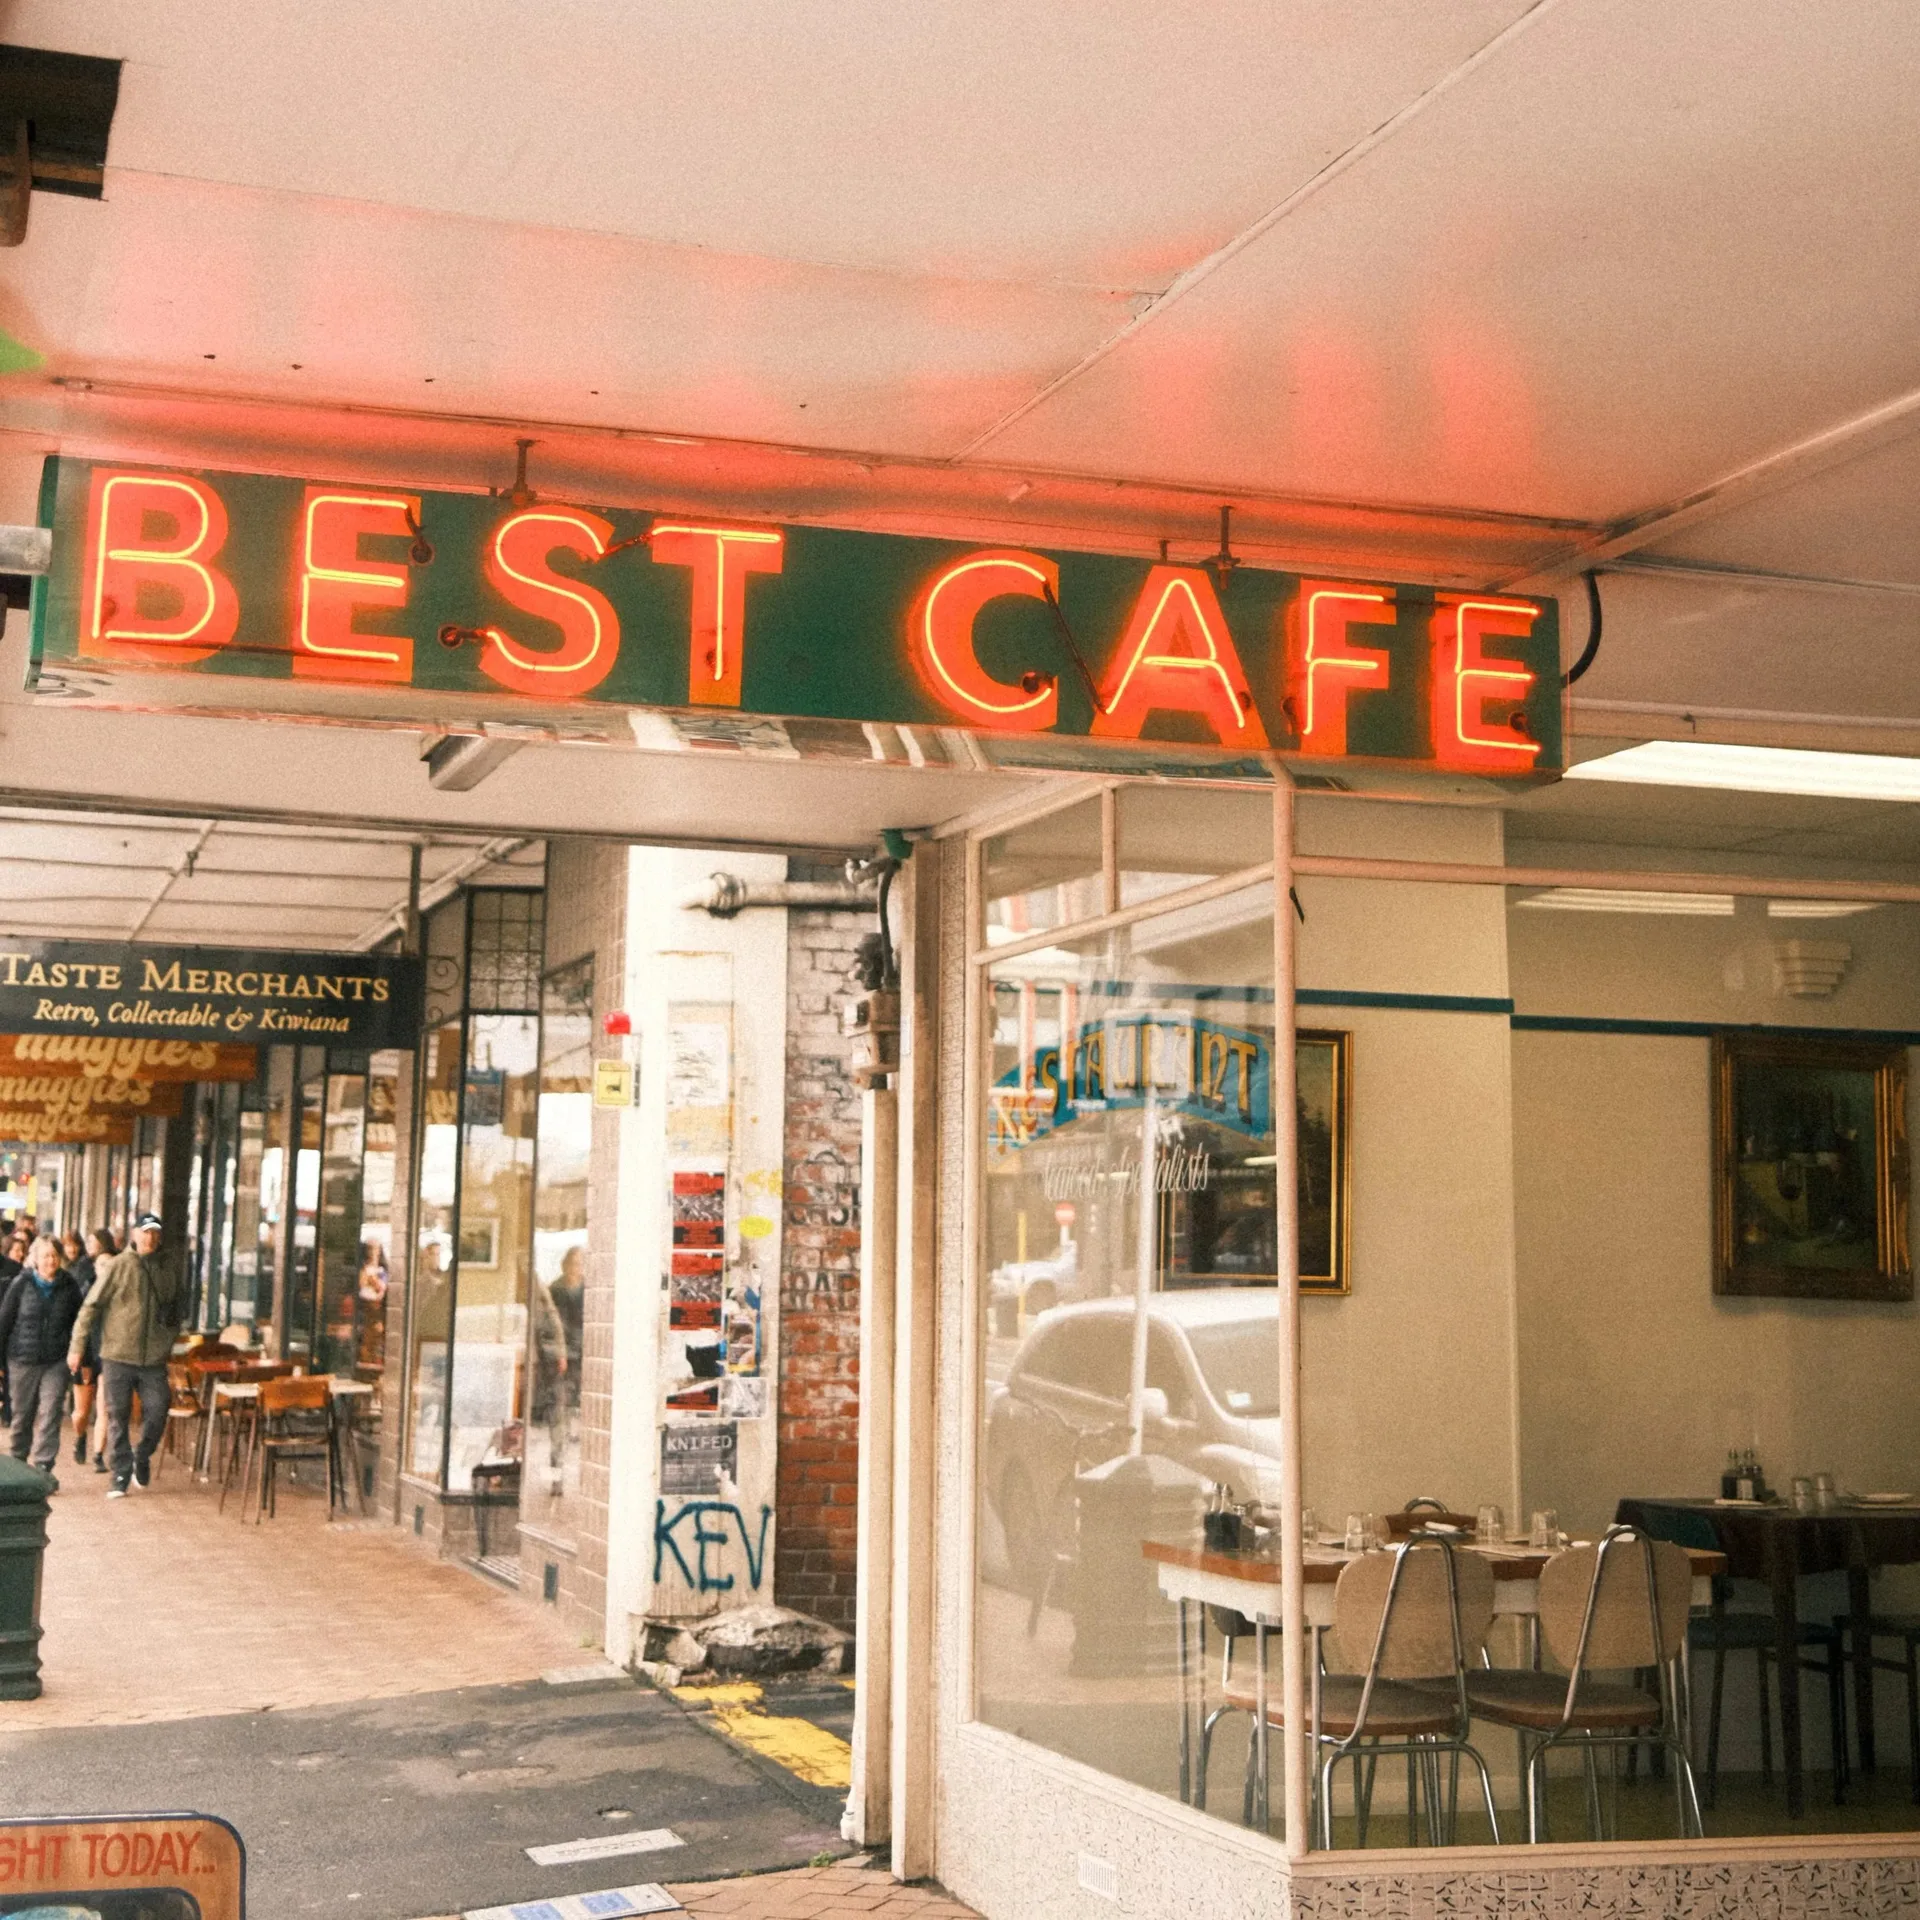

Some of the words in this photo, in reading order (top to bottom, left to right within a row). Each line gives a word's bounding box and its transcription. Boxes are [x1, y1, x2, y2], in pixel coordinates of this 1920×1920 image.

[77, 466, 784, 707] BEST
[906, 550, 1541, 773] CAFE
[33, 999, 99, 1028] Retro,
[107, 1000, 220, 1028] Collectable
[225, 1006, 253, 1032] &
[258, 1008, 350, 1033] Kiwiana
[666, 1434, 733, 1452] KNIFED
[653, 1498, 772, 1593] KEV
[81, 1831, 216, 1879] TODAY...
